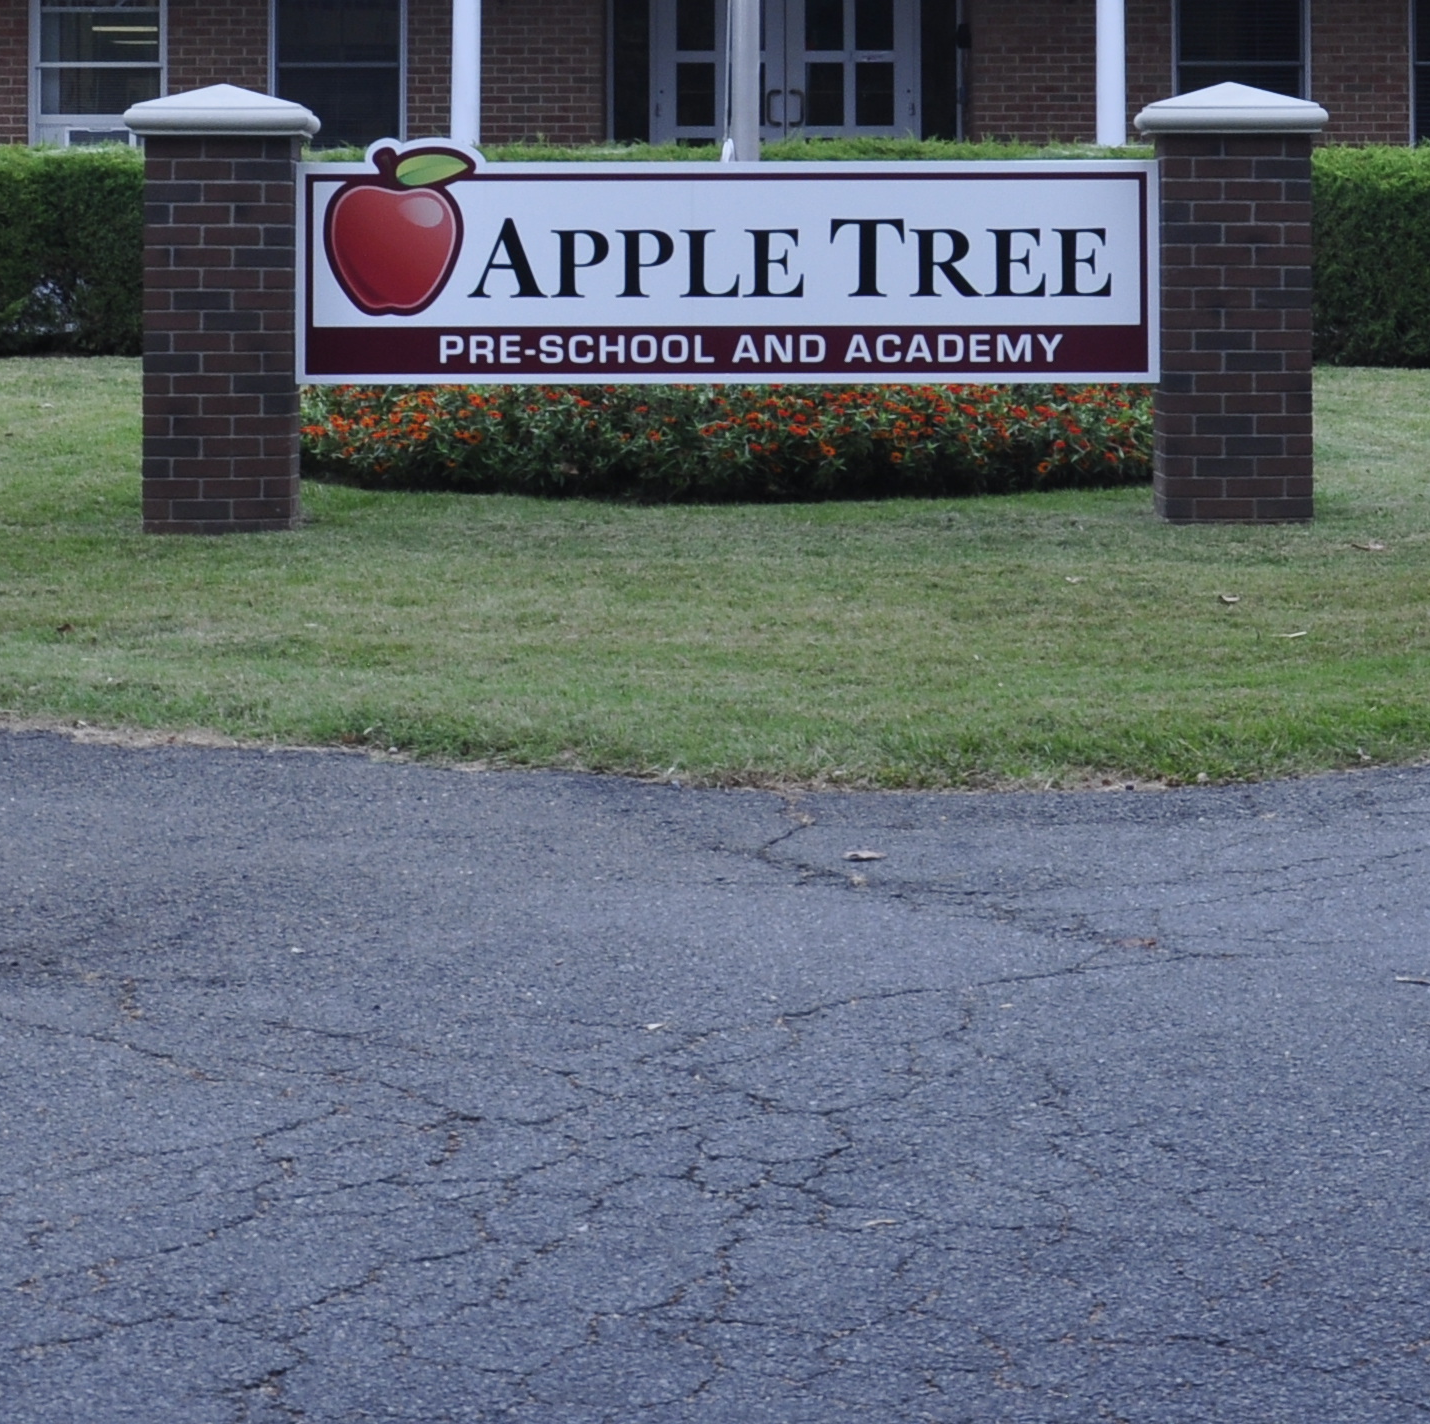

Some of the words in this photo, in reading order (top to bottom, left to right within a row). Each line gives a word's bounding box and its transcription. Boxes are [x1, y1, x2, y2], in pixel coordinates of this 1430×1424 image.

[467, 217, 805, 299] APPLE
[829, 218, 1112, 298] TREE
[439, 333, 715, 364] PRE-SCHOOL
[731, 333, 826, 364] AND
[844, 333, 1063, 364] ACADEMY
